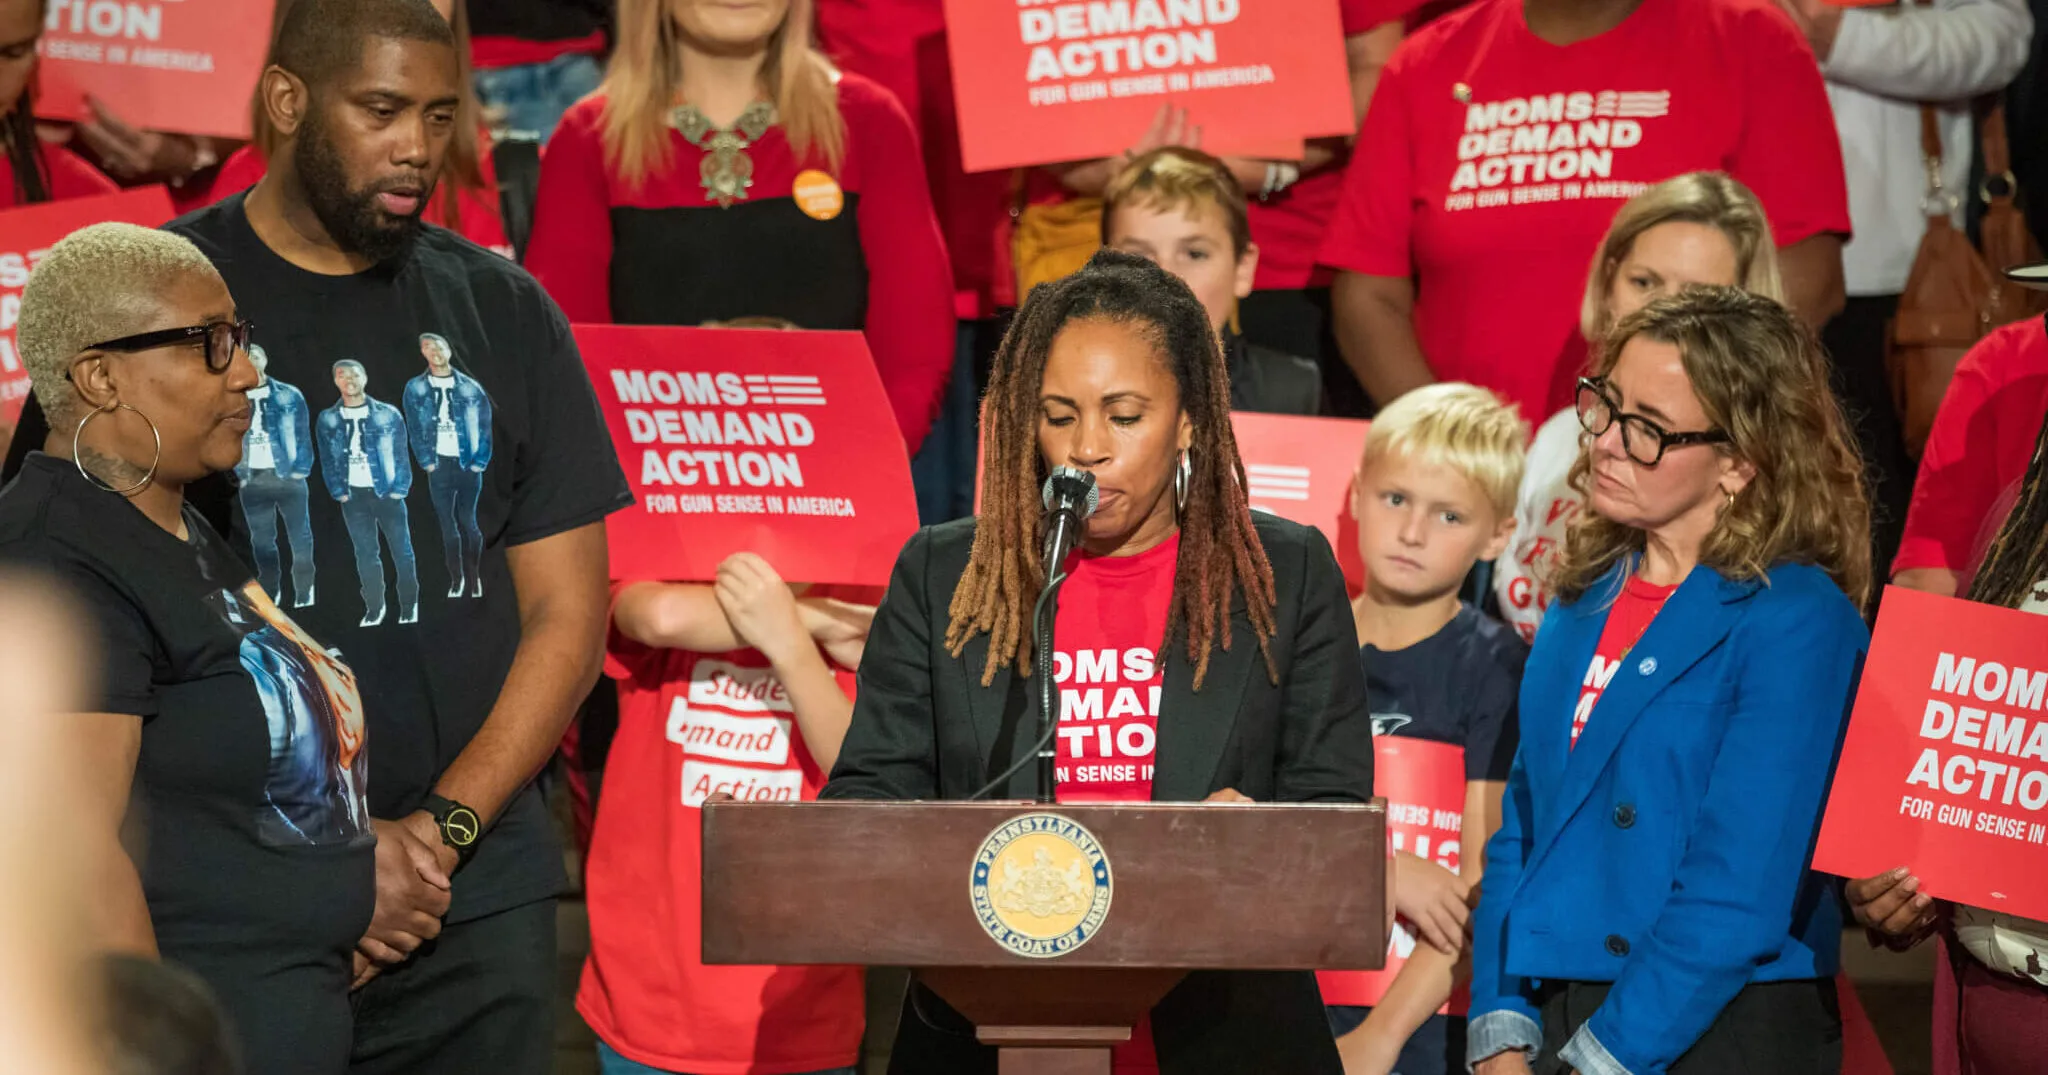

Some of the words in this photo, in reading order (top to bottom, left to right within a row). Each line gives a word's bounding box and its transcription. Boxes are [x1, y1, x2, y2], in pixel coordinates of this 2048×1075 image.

[1019, 0, 1240, 44] DEMAND
[131, 47, 215, 73] AMERICA
[1026, 29, 1217, 82] ACTION
[1029, 85, 1066, 107] FOR
[1069, 80, 1108, 101] GUN
[1110, 74, 1167, 97] SENSE
[1168, 72, 1189, 91] IN
[1192, 64, 1275, 89] AMERICA
[1465, 91, 1594, 132] MOMS
[1458, 119, 1642, 160] DEMAND
[1451, 149, 1613, 192] ACTION
[1445, 193, 1474, 212] FOR
[1475, 189, 1509, 208] GUN
[1511, 185, 1561, 205] SENSE
[1562, 183, 1582, 199] IN
[610, 369, 748, 406] MOMS
[624, 408, 815, 446] DEMAND
[641, 449, 804, 487] ACTION
[645, 494, 677, 513] FOR
[681, 496, 714, 514] GUN
[716, 496, 765, 515] SENSE
[767, 497, 784, 515] IN
[787, 497, 856, 517] AMERICA
[1931, 652, 2048, 711] MOM
[679, 722, 777, 752] mand
[1076, 764, 1136, 782] SENSE
[1906, 748, 2048, 811] ACTIO
[1899, 795, 1933, 820] FOR
[1937, 806, 1972, 829] GUN
[1975, 814, 2025, 841] SENSE
[2027, 823, 2045, 845] IN
[980, 817, 1102, 866] PENNSYLVANIA
[974, 885, 1008, 941] STATE
[1006, 933, 1054, 954] COAT
[1056, 931, 1081, 951] OF
[1082, 886, 1110, 937] ARMS
